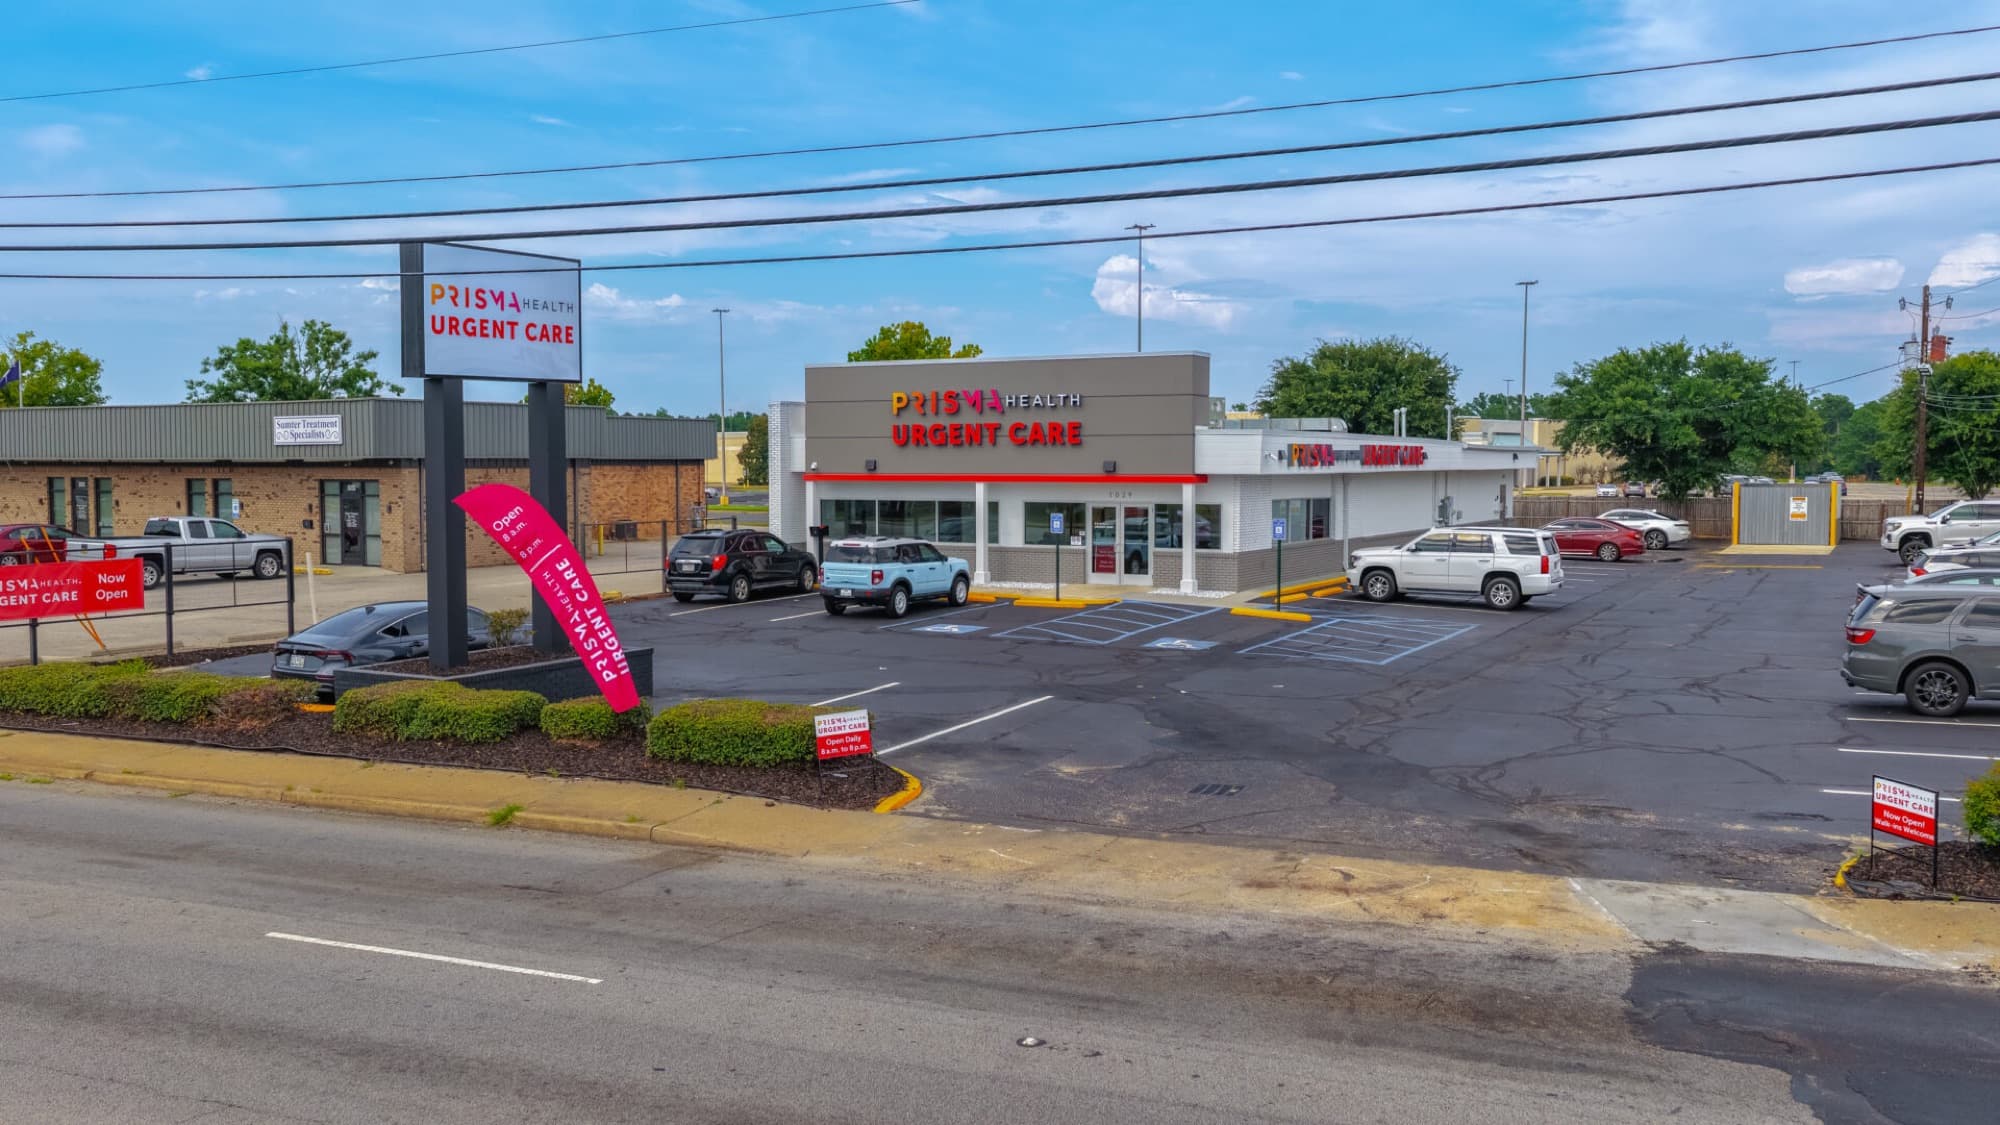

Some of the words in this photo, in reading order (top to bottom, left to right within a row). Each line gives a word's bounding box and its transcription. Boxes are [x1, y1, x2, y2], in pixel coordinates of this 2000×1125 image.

[431, 283, 521, 313] PRISMA
[523, 298, 574, 313] HEALTH
[431, 315, 519, 340] URGENT
[525, 322, 574, 344] CARE
[892, 389, 1004, 415] PRISMA
[1006, 393, 1081, 408] HEALTH
[276, 420, 301, 429] Sumter
[301, 419, 337, 429] Treatment
[290, 429, 325, 441] Specialists
[892, 422, 1001, 446] URGENT
[1008, 421, 1082, 445] CARE
[492, 505, 524, 532] Open
[502, 533, 511, 543] 8
[510, 521, 528, 536] a.m.
[519, 550, 527, 559] 8
[526, 537, 544, 555] p.m.
[98, 573, 126, 584] Now
[555, 558, 589, 602] CARE
[42, 591, 78, 603] CARE
[95, 589, 128, 602] Open
[543, 571, 573, 612] HEALTH
[569, 610, 617, 682] PRISMA
[584, 607, 630, 675] URGENT
[818, 725, 846, 734] URGENT
[849, 722, 866, 730] CARE
[825, 737, 845, 746] Open
[845, 735, 861, 743] Daily
[1876, 782, 1910, 798] PRISMA
[1875, 792, 1910, 808] URGENT
[1912, 802, 1934, 814] CARE
[1874, 818, 1903, 831] Walk-ins
[1883, 809, 1901, 821] Now
[1902, 815, 1925, 828] Open!
